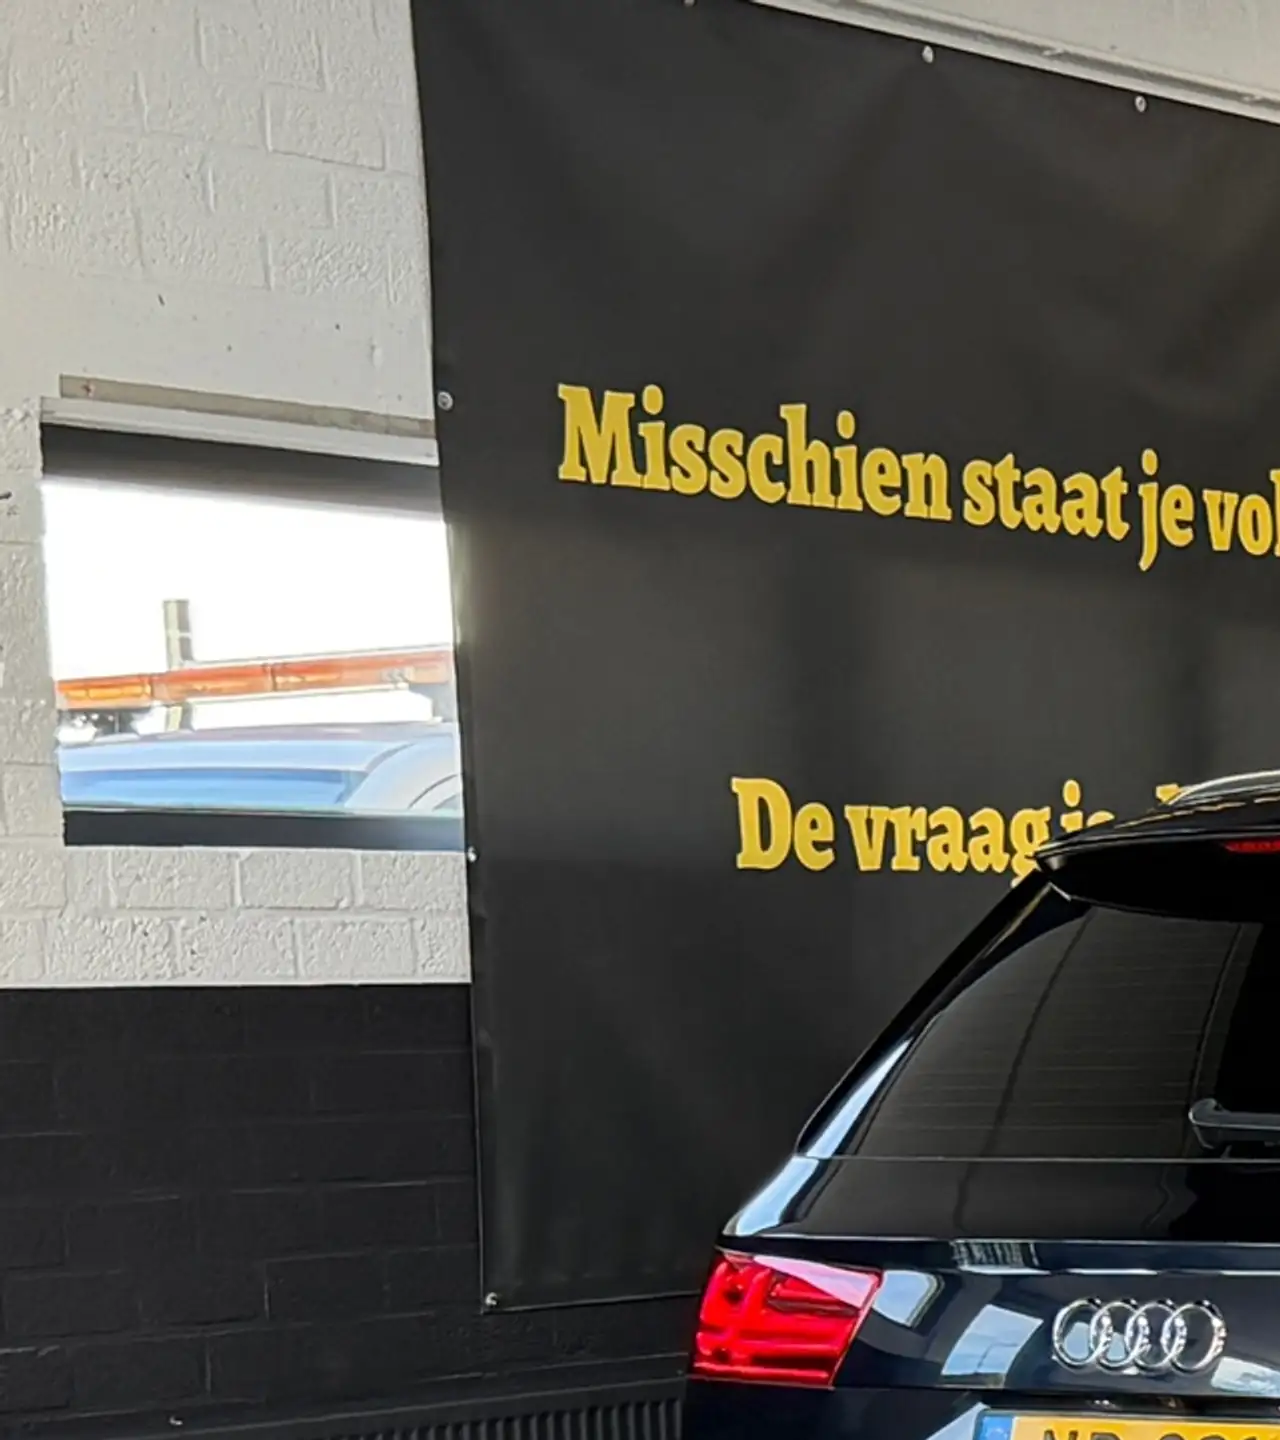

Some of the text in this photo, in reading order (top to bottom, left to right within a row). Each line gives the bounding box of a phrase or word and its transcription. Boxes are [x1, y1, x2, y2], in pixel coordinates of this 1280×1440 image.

[558, 383, 953, 522] Misschien
[962, 455, 1130, 541] staat
[1138, 448, 1195, 571] je
[730, 776, 1115, 888] De vraag i
